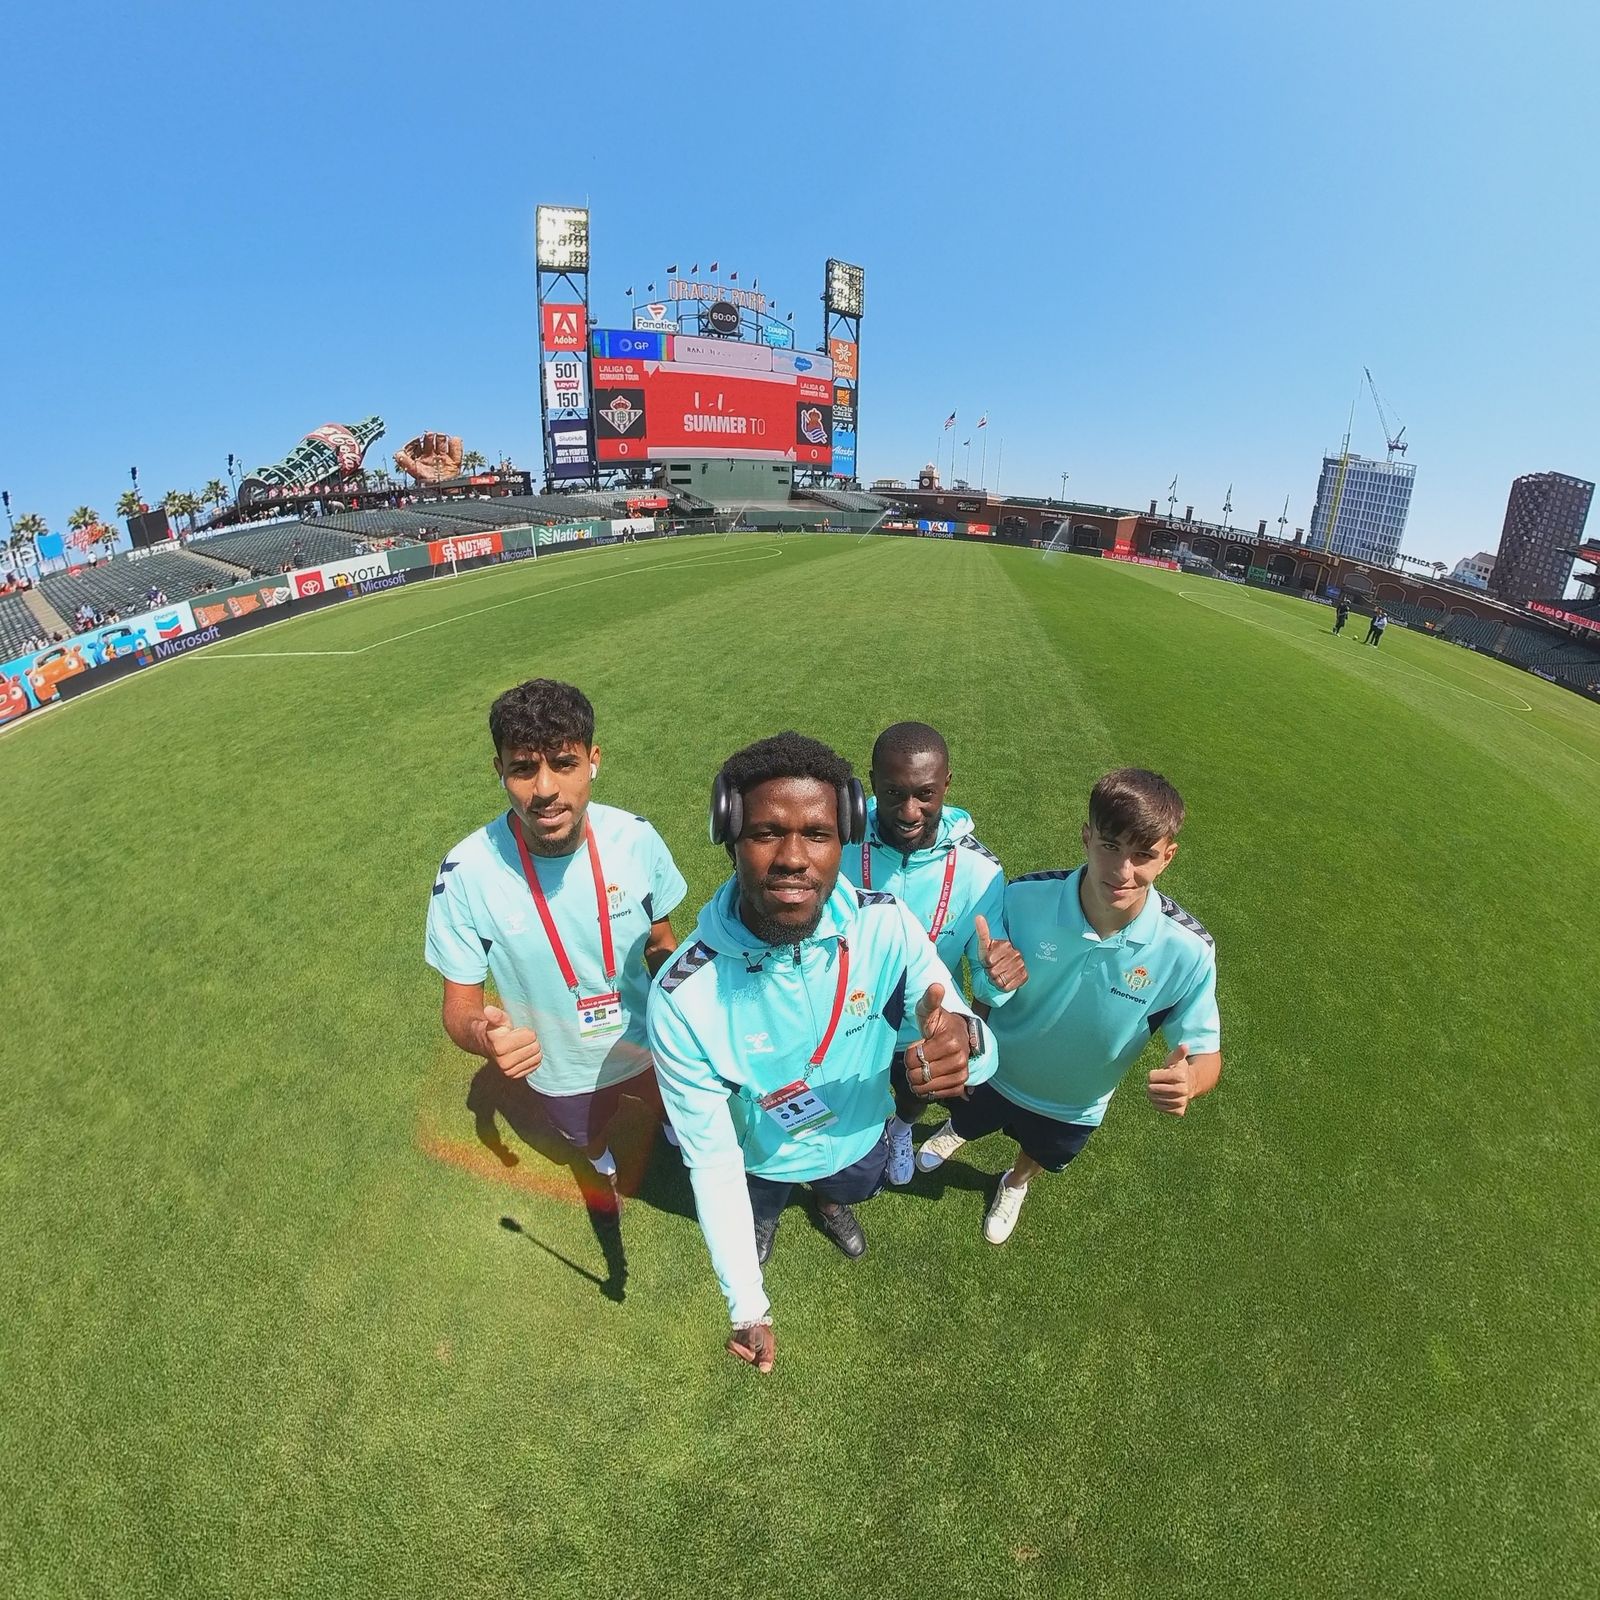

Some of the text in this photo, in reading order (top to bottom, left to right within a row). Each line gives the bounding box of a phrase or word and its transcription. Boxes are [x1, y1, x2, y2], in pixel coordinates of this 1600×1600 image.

[668, 279, 767, 313] ORACLE PARK
[712, 312, 737, 323] 60:00
[637, 318, 679, 332] Fanatics
[553, 335, 578, 345] Adobe
[555, 363, 577, 378] 501
[598, 365, 624, 373] LALIGA
[556, 392, 579, 408] 150
[683, 413, 766, 436] SUMMER TO
[618, 443, 628, 454] 0
[810, 449, 818, 459] 0
[927, 521, 949, 533] VISA
[924, 531, 954, 539] Microsoft
[1202, 527, 1260, 546] LANDING
[501, 548, 533, 561] Microsoft
[1111, 553, 1132, 562] LALIGA
[360, 572, 406, 593] Microsoft
[155, 625, 221, 658] Microsoft
[1110, 987, 1148, 1005] finetwork
